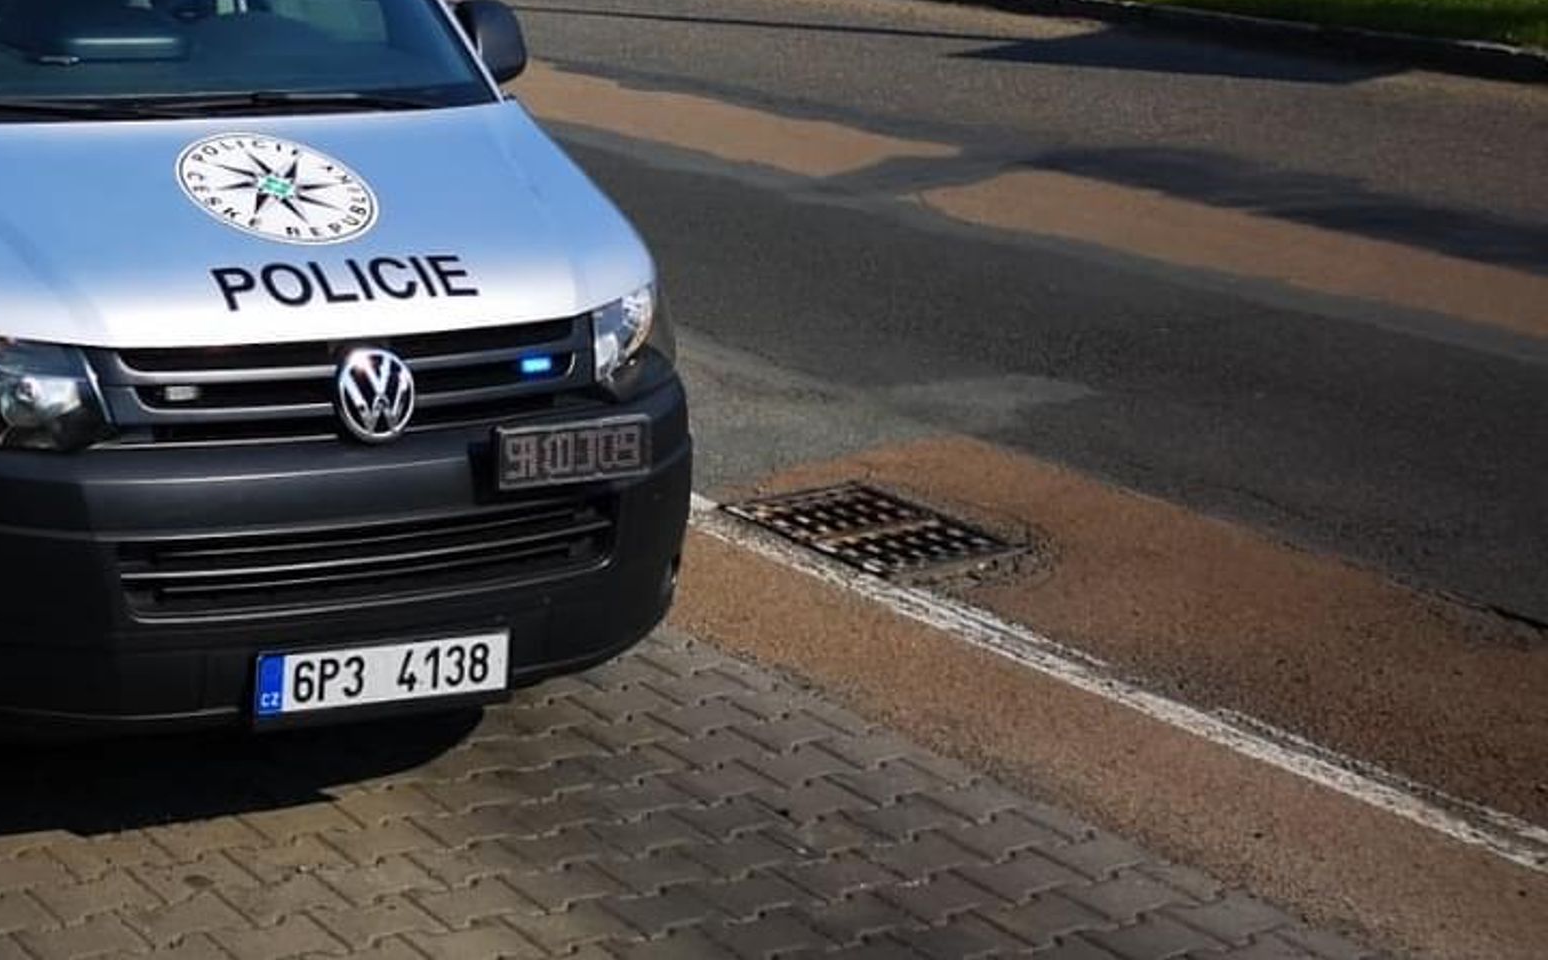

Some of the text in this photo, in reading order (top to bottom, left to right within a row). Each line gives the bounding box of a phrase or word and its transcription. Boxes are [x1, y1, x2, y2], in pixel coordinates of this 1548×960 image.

[210, 255, 480, 312] POLICIE
[292, 642, 490, 704] 6P3 4138
